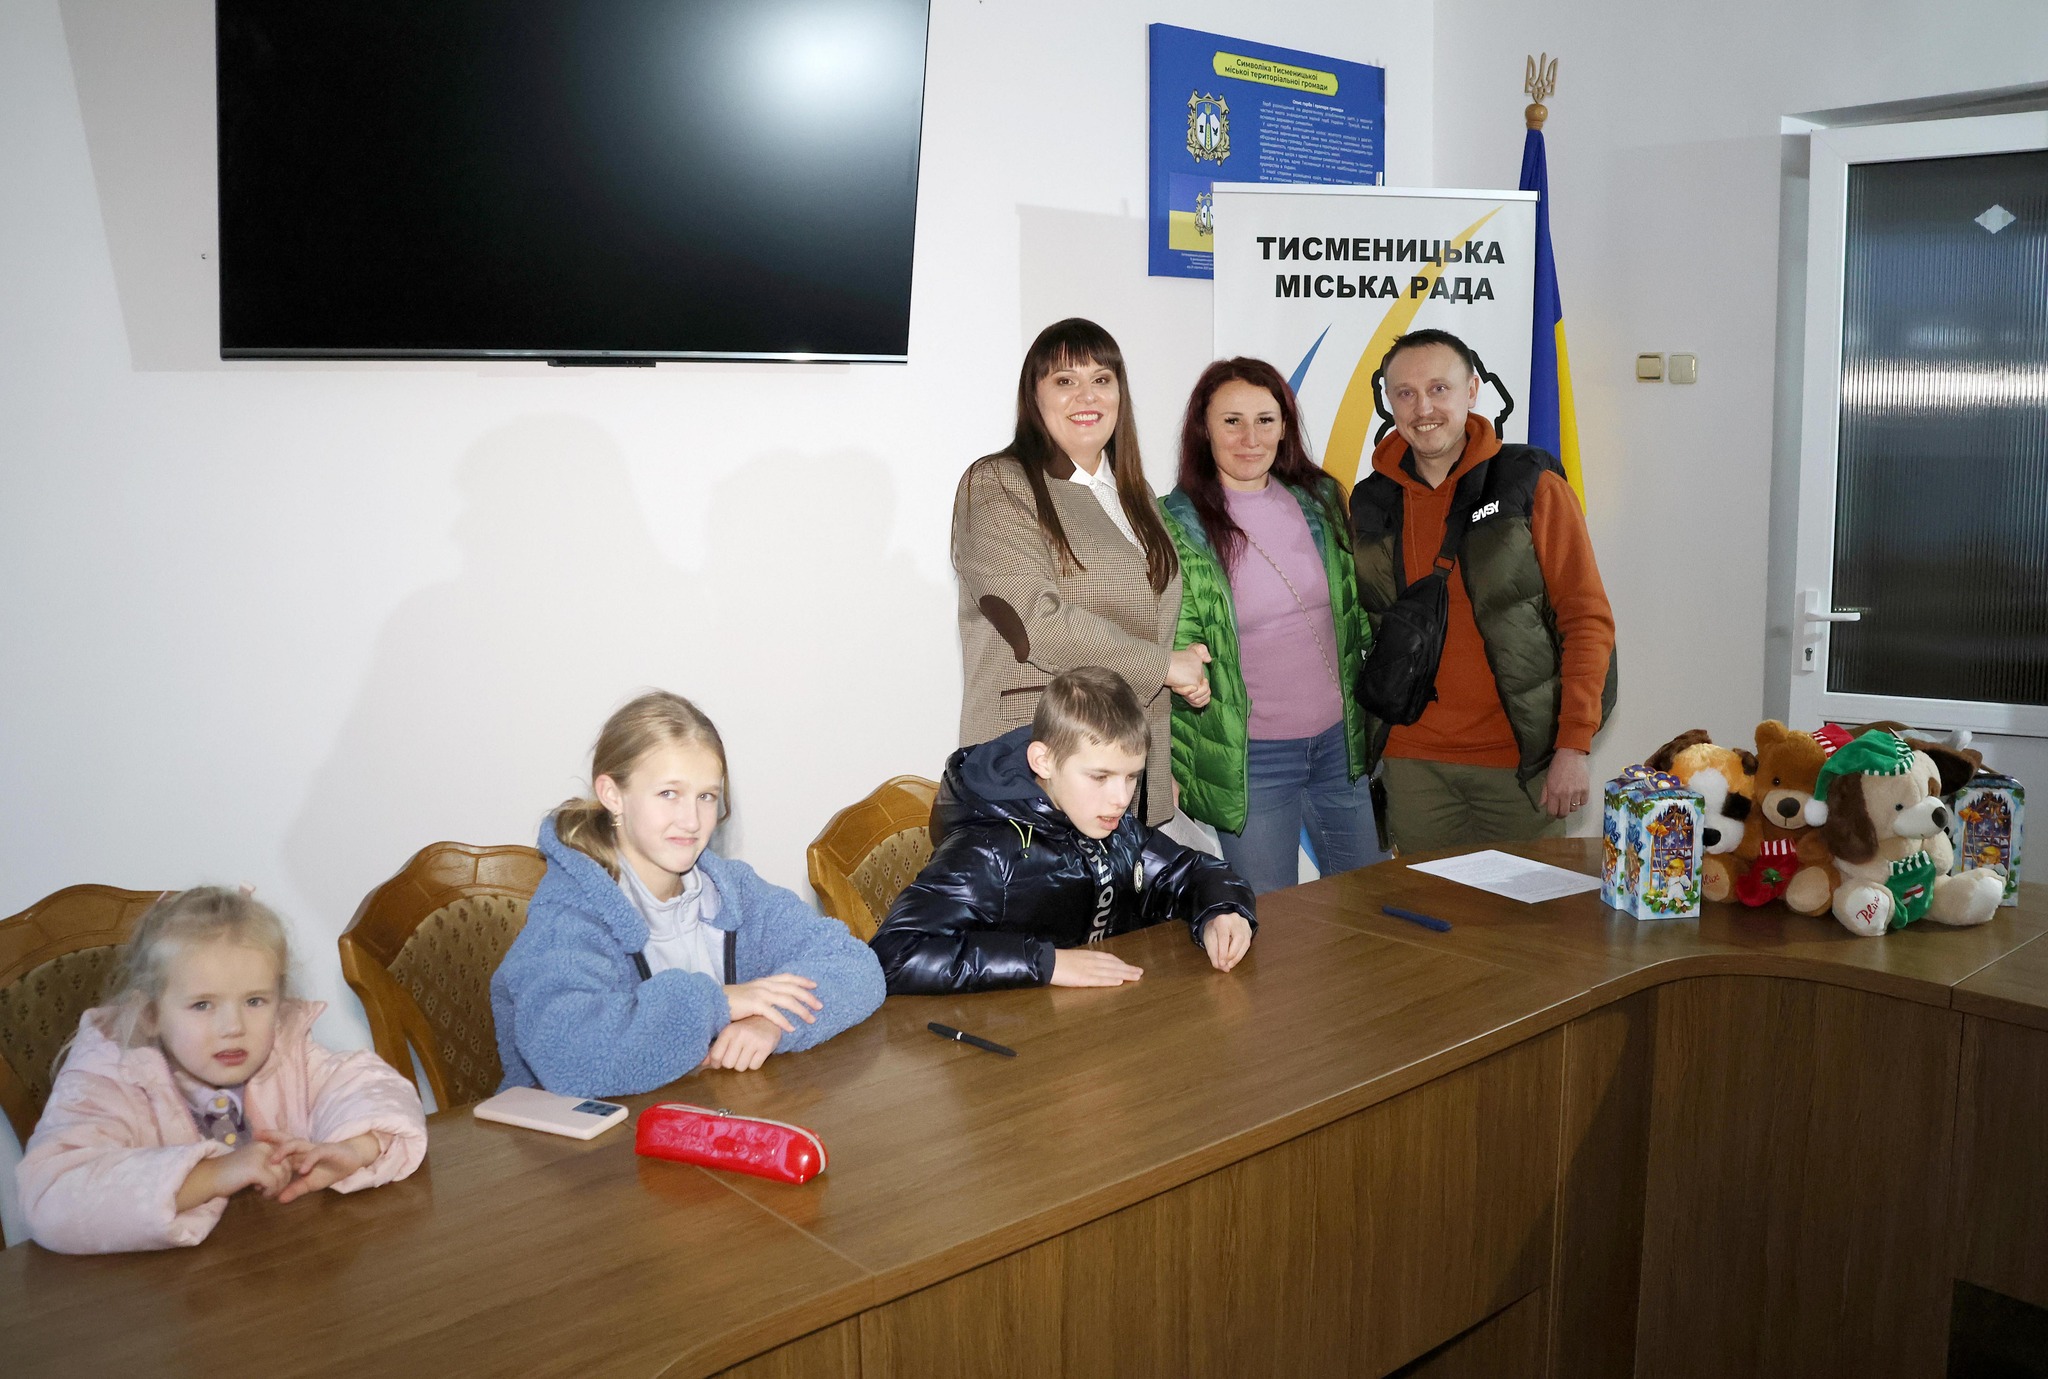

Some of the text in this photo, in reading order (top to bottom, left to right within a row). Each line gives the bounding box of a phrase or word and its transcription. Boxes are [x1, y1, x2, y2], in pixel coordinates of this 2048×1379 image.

[1224, 66, 1328, 91] міської територіальної громади
[1236, 58, 1318, 81] Символіка Тисменицької
[1256, 236, 1505, 267] ТИСМЕНИЦЬКА
[1275, 274, 1495, 304] МІСЬКА РАДА
